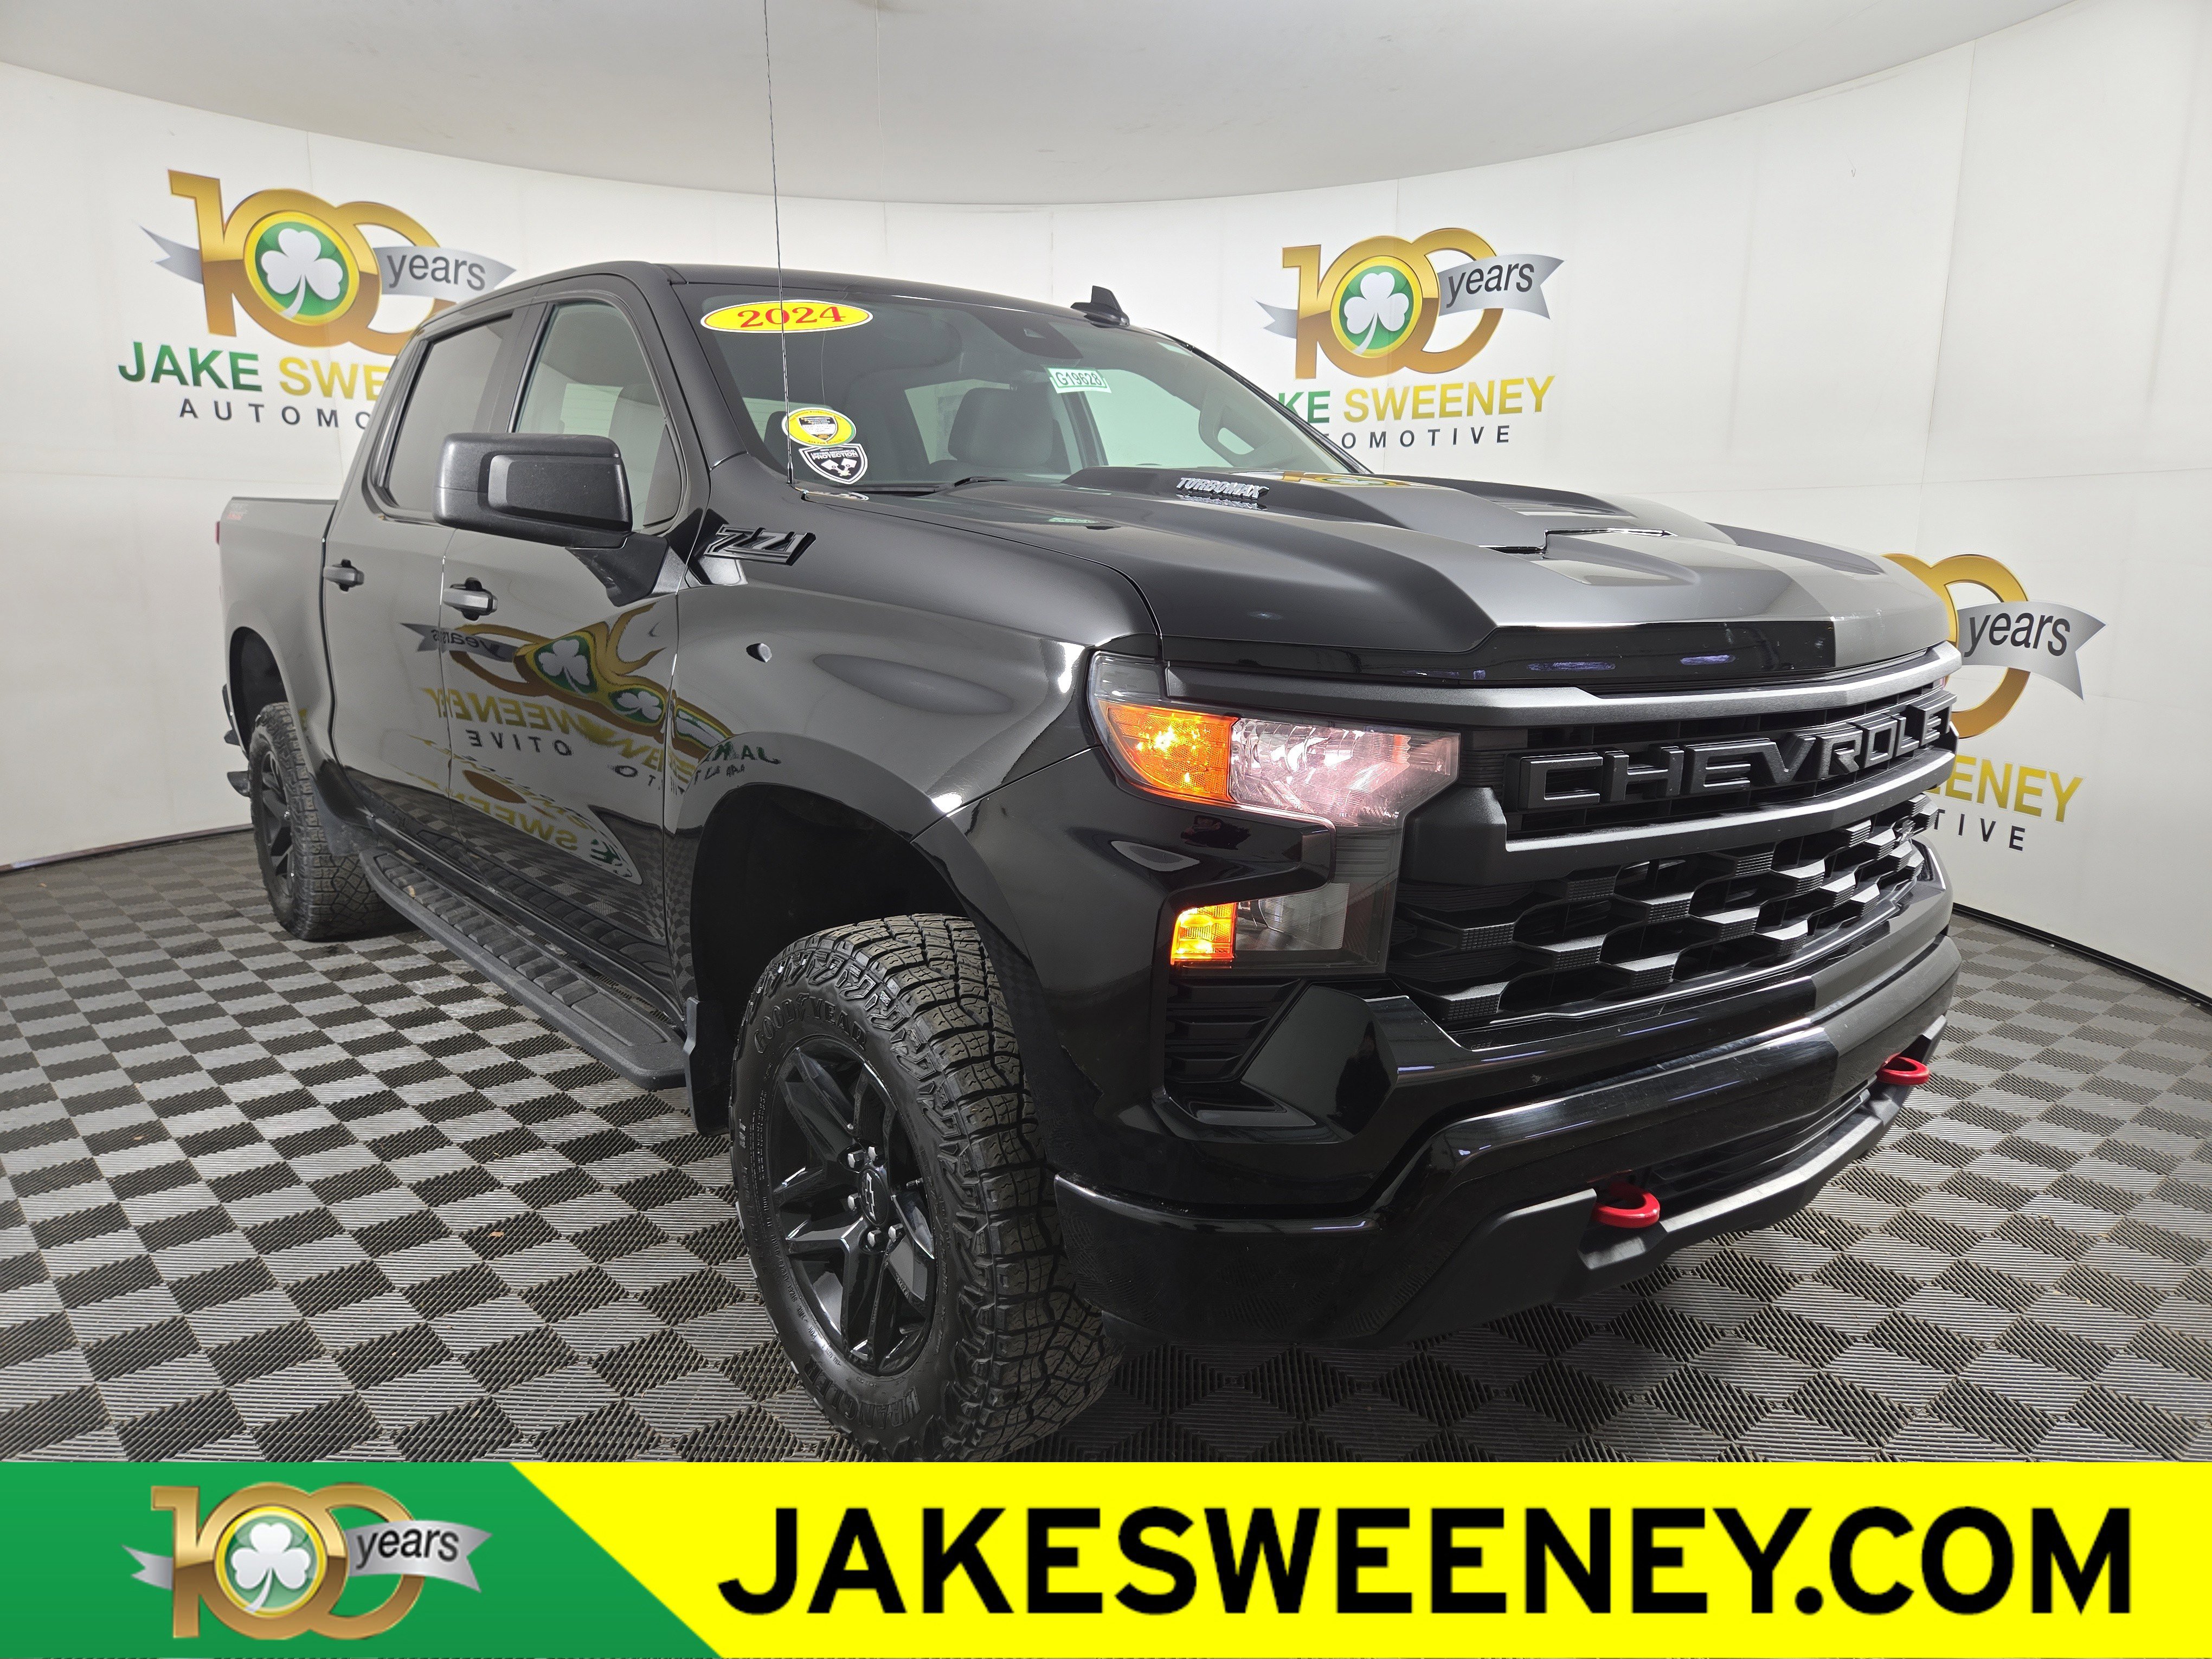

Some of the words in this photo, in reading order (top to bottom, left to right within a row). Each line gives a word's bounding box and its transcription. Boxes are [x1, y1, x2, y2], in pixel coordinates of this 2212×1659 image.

[387, 252, 486, 291] years
[1446, 262, 1534, 307] years
[737, 306, 846, 328] 2024
[118, 341, 263, 392] JAKE
[278, 356, 390, 401] SWE
[1055, 372, 1102, 385] G19628
[179, 398, 371, 429] AUTOMO
[1278, 390, 1331, 423] KE
[1343, 375, 1555, 423] SWEENEY
[1323, 425, 1510, 449] OMOTIVE
[812, 452, 858, 460] PROTECTION
[1176, 477, 1270, 500] TURBOMAX
[1964, 612, 2071, 657] years
[1934, 808, 2026, 852] TIVE
